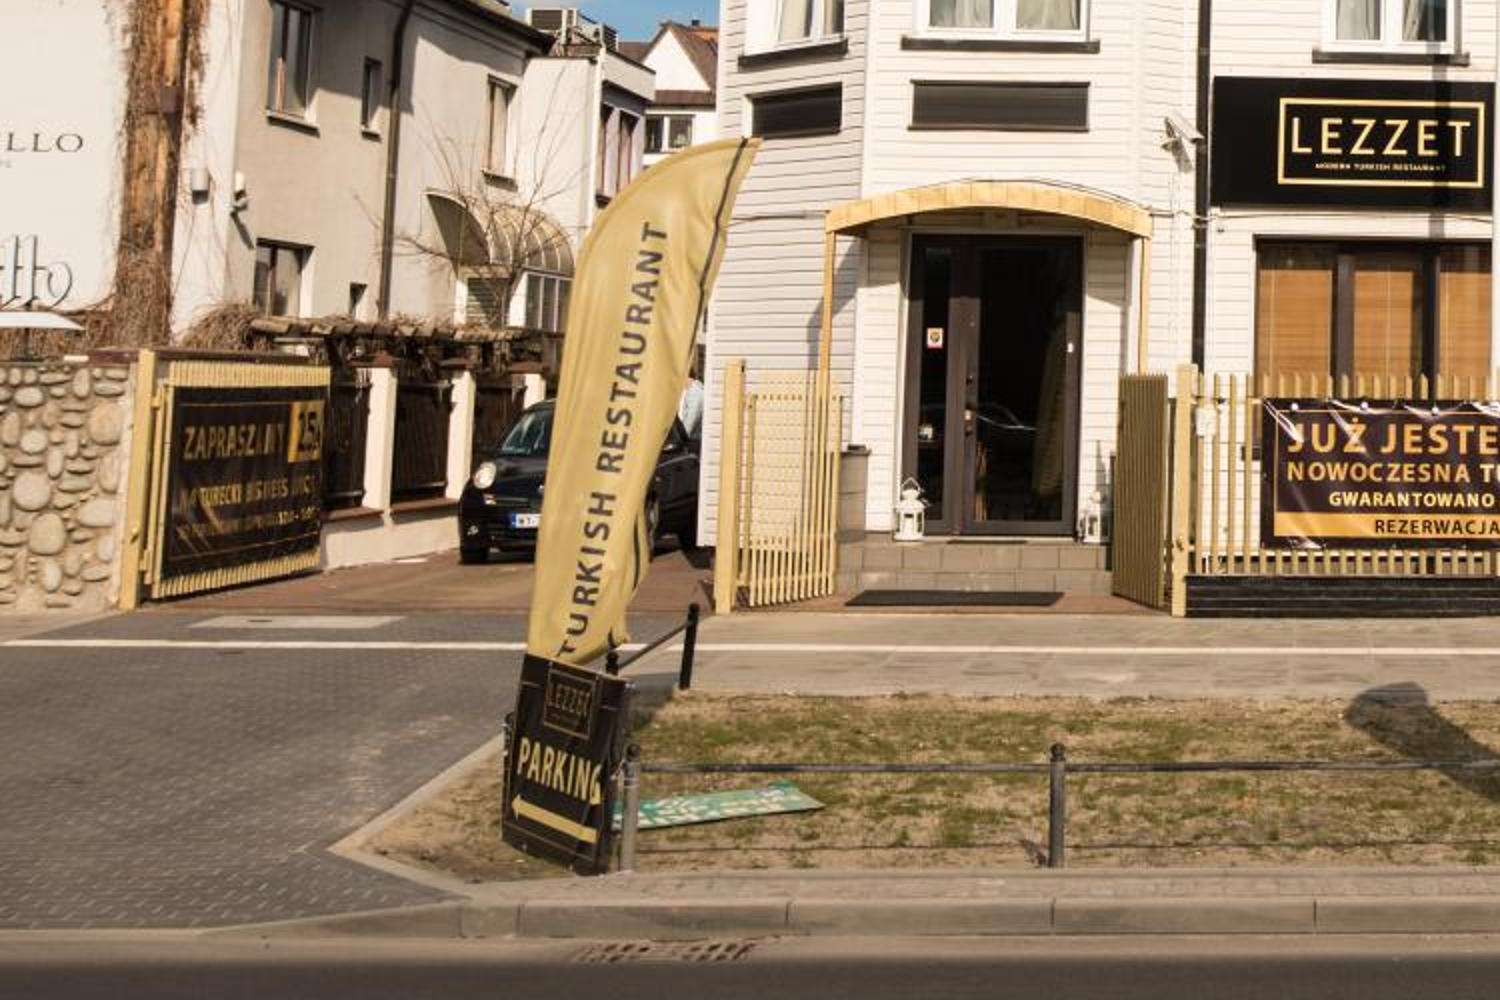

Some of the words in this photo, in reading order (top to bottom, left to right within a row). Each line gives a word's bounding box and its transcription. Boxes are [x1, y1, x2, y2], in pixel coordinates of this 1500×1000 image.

[1291, 117, 1471, 157] LEZZET
[596, 222, 667, 473] RESTAURANT
[1287, 417, 1368, 454] JUŻ
[1287, 461, 1471, 484] NOWOCZESNA
[1329, 491, 1495, 508] GWARANTOWANO
[556, 491, 616, 657] TURKISH
[517, 738, 603, 805] PARKING
